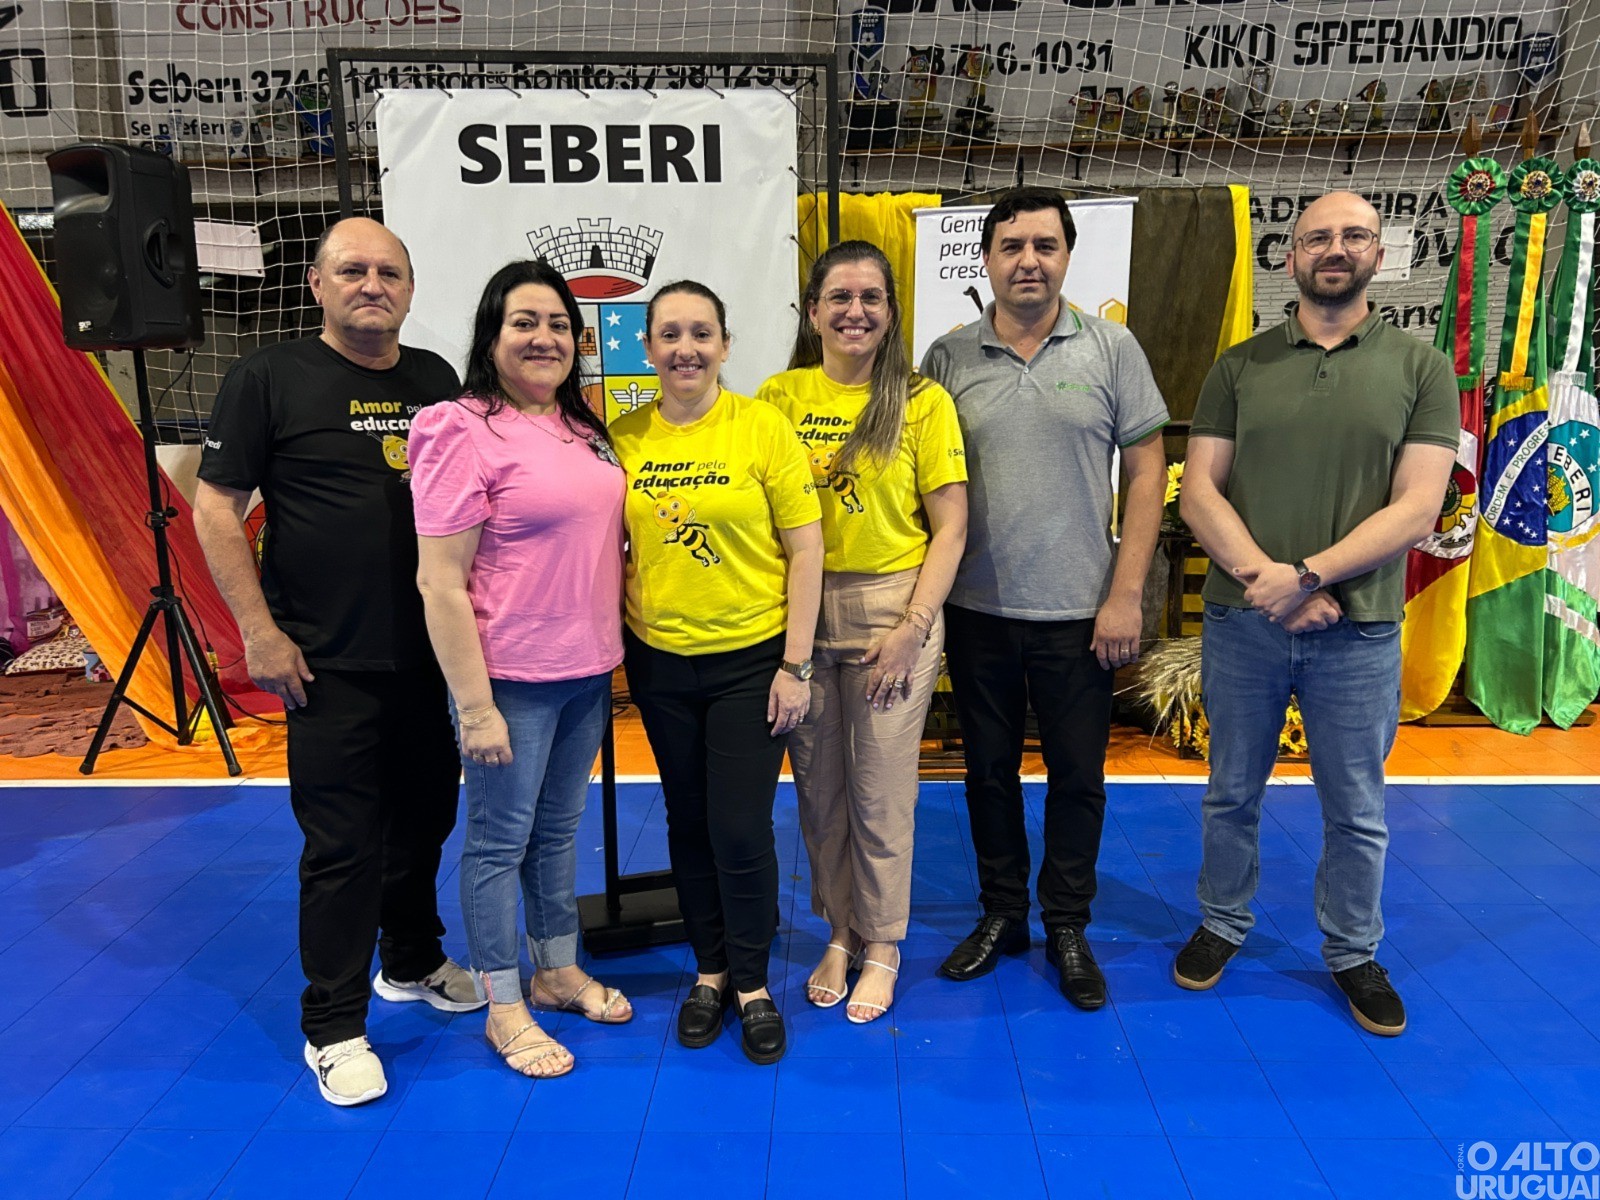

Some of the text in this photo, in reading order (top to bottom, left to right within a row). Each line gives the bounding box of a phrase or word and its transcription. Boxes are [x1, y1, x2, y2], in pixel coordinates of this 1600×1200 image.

[1184, 17, 1522, 70] KIKO SPERANDIO
[131, 120, 151, 136] Se
[458, 123, 722, 185] SEBERI
[350, 400, 402, 416] Amor
[799, 412, 852, 427] Amor
[639, 459, 727, 474] Amor pela
[632, 471, 731, 491] educação
[1486, 484, 1509, 521] ORDEM
[1504, 471, 1516, 481] E
